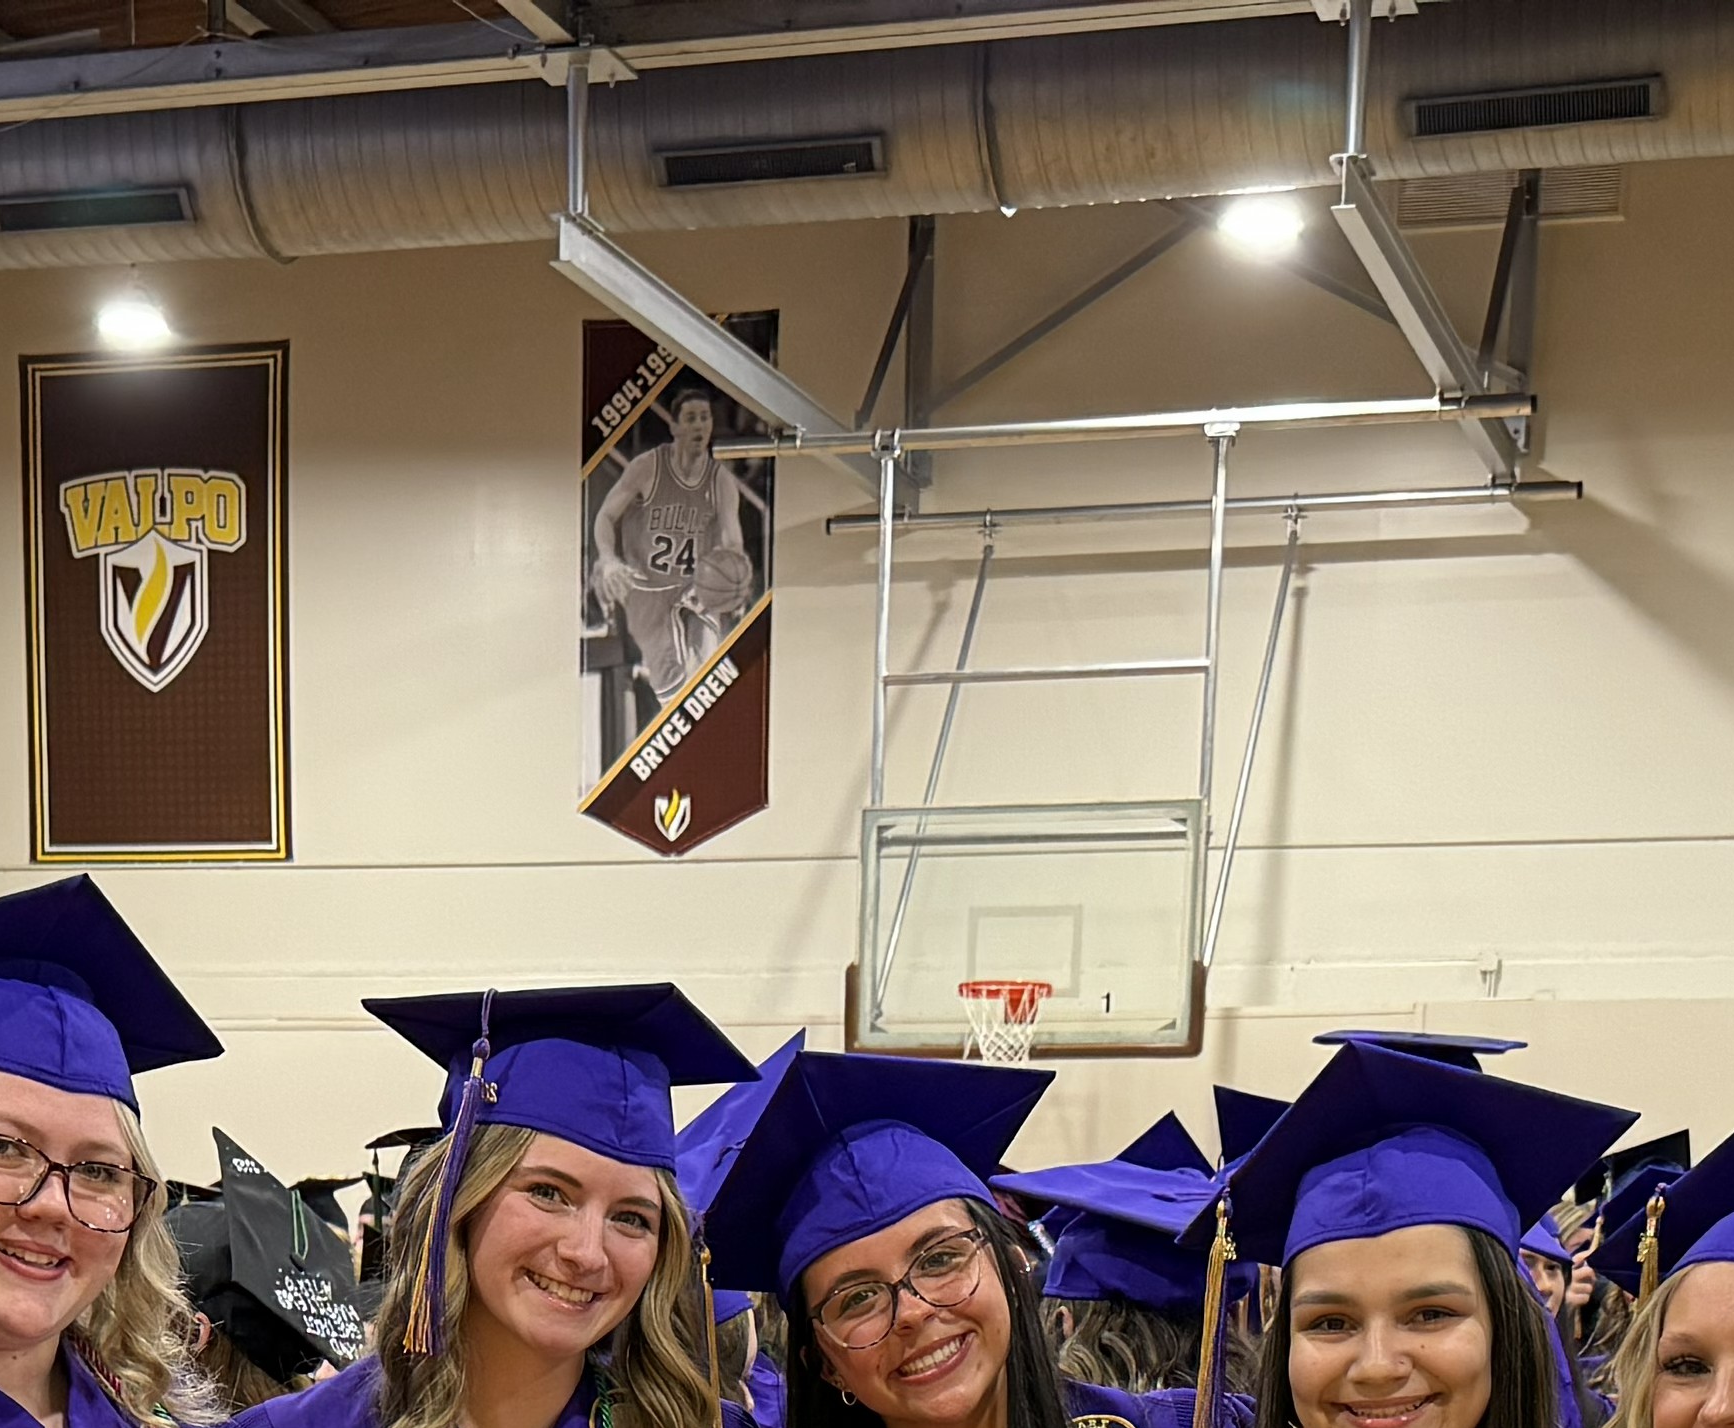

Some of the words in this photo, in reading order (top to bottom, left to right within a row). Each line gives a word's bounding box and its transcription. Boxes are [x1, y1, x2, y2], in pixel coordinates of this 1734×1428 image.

[63, 472, 243, 554] VALPO
[649, 533, 696, 576] 24
[630, 712, 692, 781] BRYCE
[684, 657, 739, 721] DREW
[1101, 992, 1111, 1013] 1
